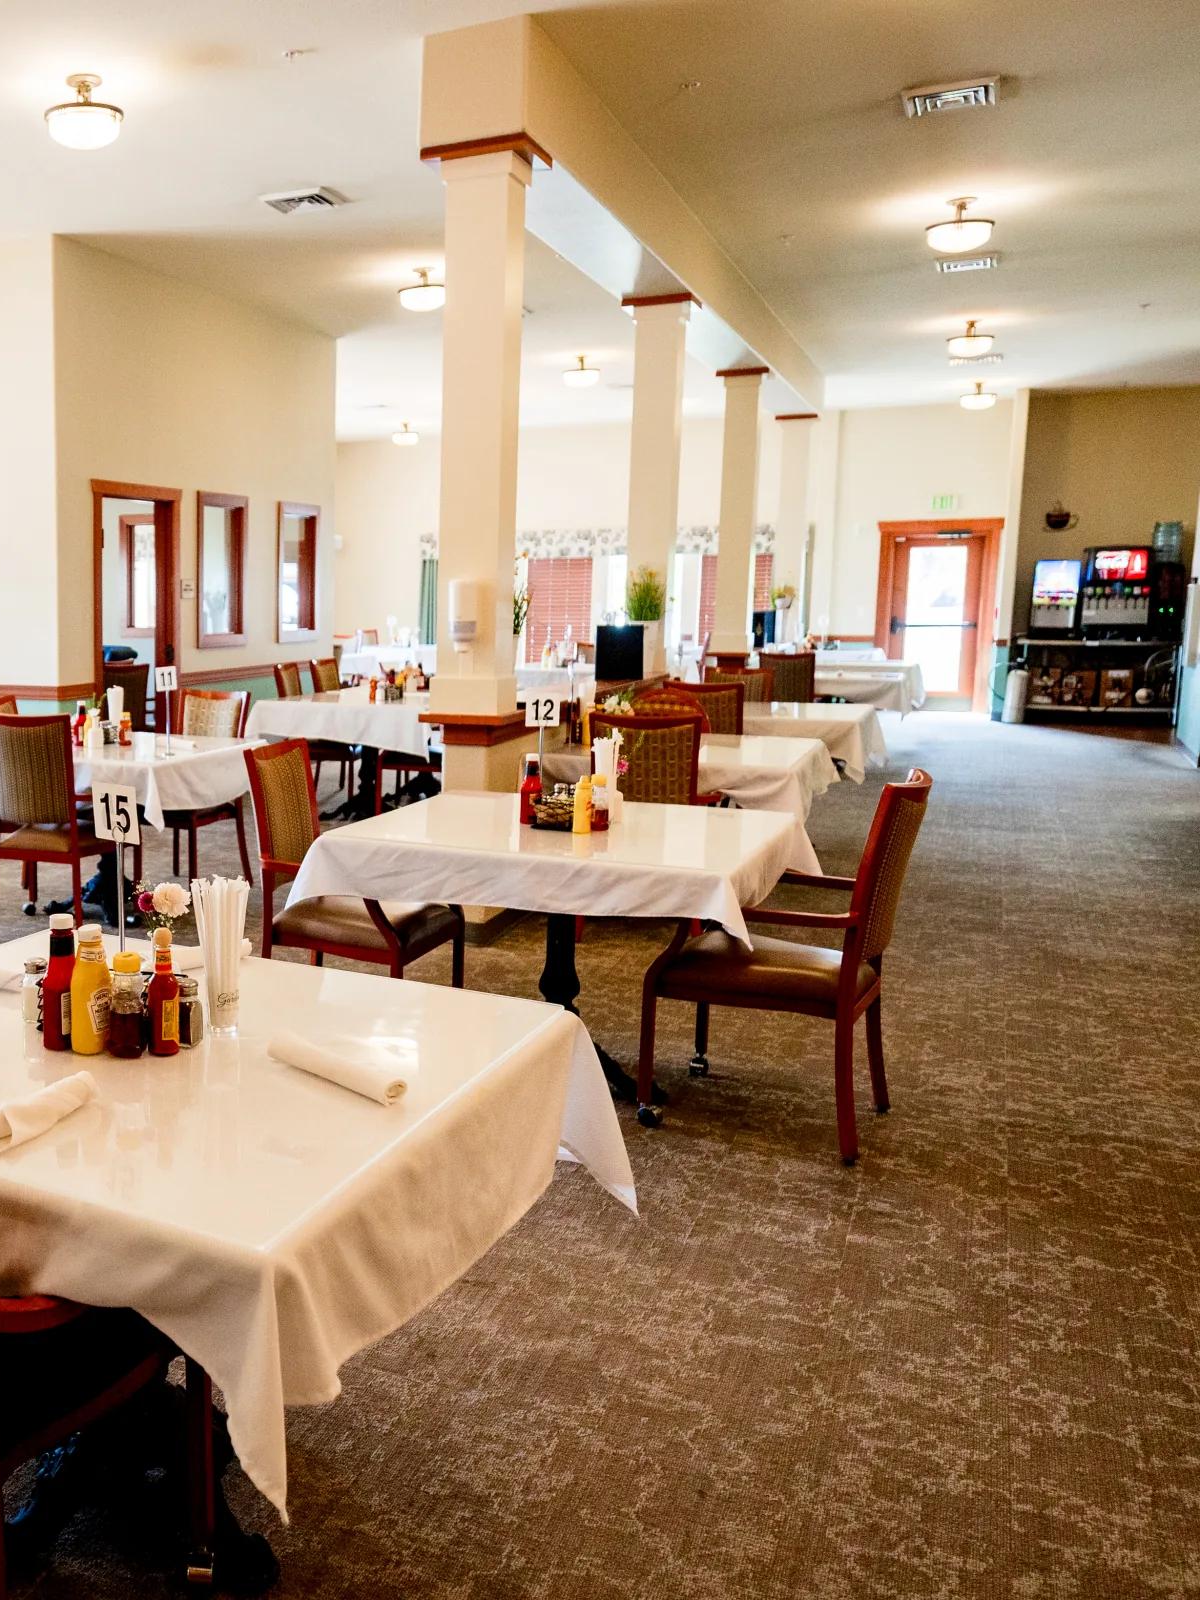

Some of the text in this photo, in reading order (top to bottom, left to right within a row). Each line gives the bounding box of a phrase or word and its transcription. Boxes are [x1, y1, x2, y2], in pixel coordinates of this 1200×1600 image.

[160, 671, 173, 687] 11
[531, 699, 554, 721] 12
[99, 792, 131, 834] 15
